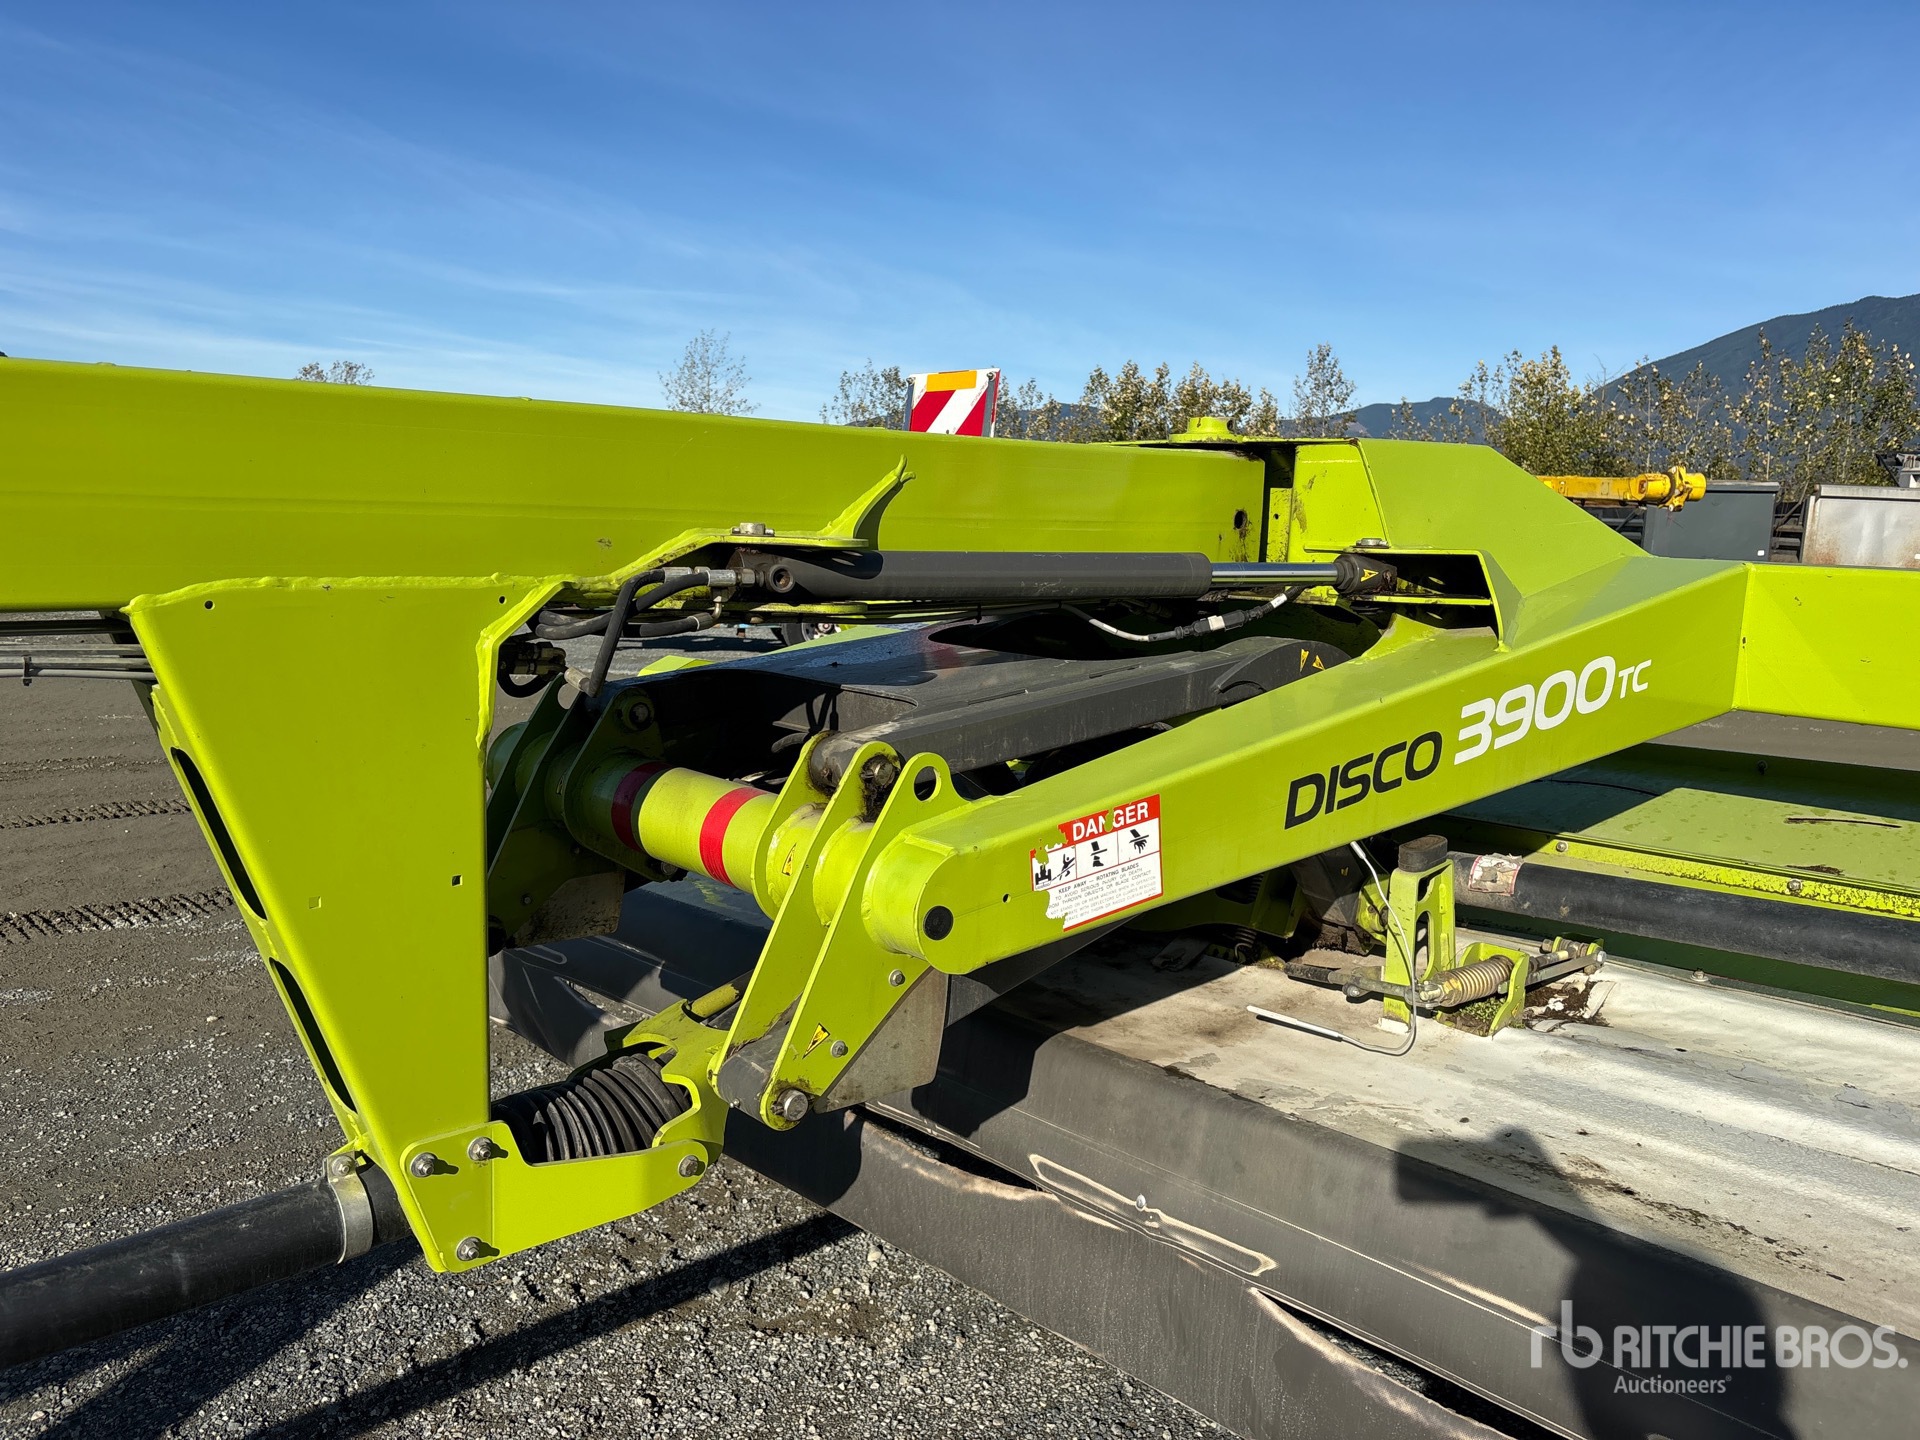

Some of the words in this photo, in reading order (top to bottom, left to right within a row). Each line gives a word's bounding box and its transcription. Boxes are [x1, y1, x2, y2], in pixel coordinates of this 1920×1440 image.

[1284, 730, 1443, 830] DISCO
[1059, 886, 1071, 894] KEEP
[1074, 881, 1086, 889] AWAY
[1096, 870, 1119, 881] ROTATING
[1121, 863, 1139, 873] BLADES
[1065, 890, 1078, 898] AVOID
[1081, 883, 1099, 893] SERIOUS
[1129, 868, 1142, 876] DEATH
[1084, 887, 1103, 897] OBJECTS
[1115, 879, 1129, 887] BLADE
[1132, 871, 1151, 881] CONTACT
